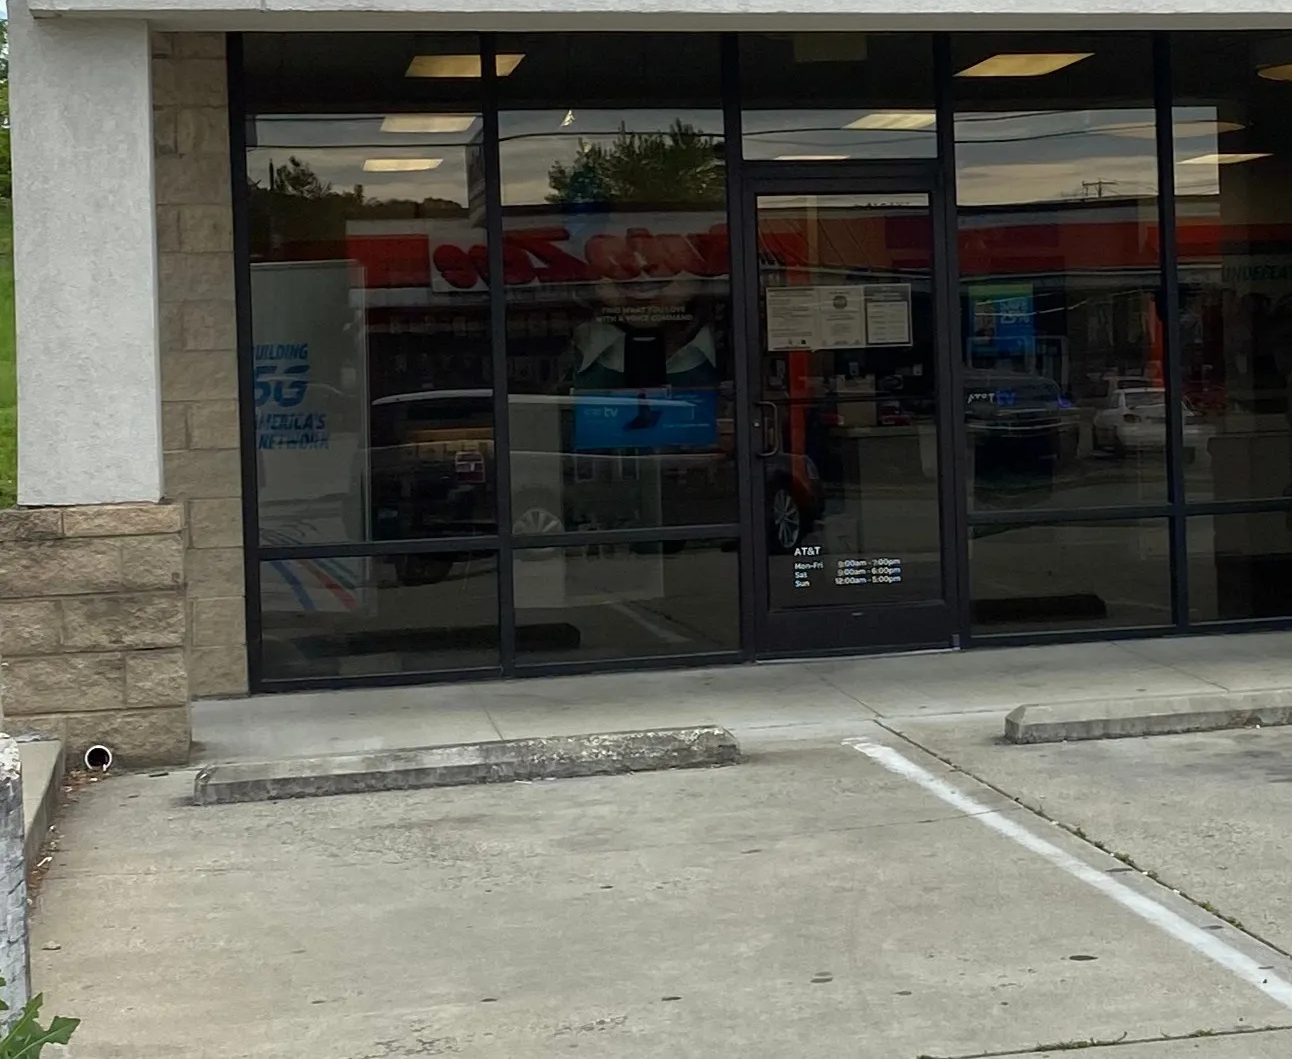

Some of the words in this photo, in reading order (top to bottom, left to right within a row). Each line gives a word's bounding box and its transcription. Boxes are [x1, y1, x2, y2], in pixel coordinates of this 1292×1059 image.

[255, 343, 309, 360] UILDING
[794, 546, 821, 557] AT&T
[794, 561, 824, 570] Mon-Fri
[794, 571, 808, 579] Sat
[794, 580, 810, 588] Sun
